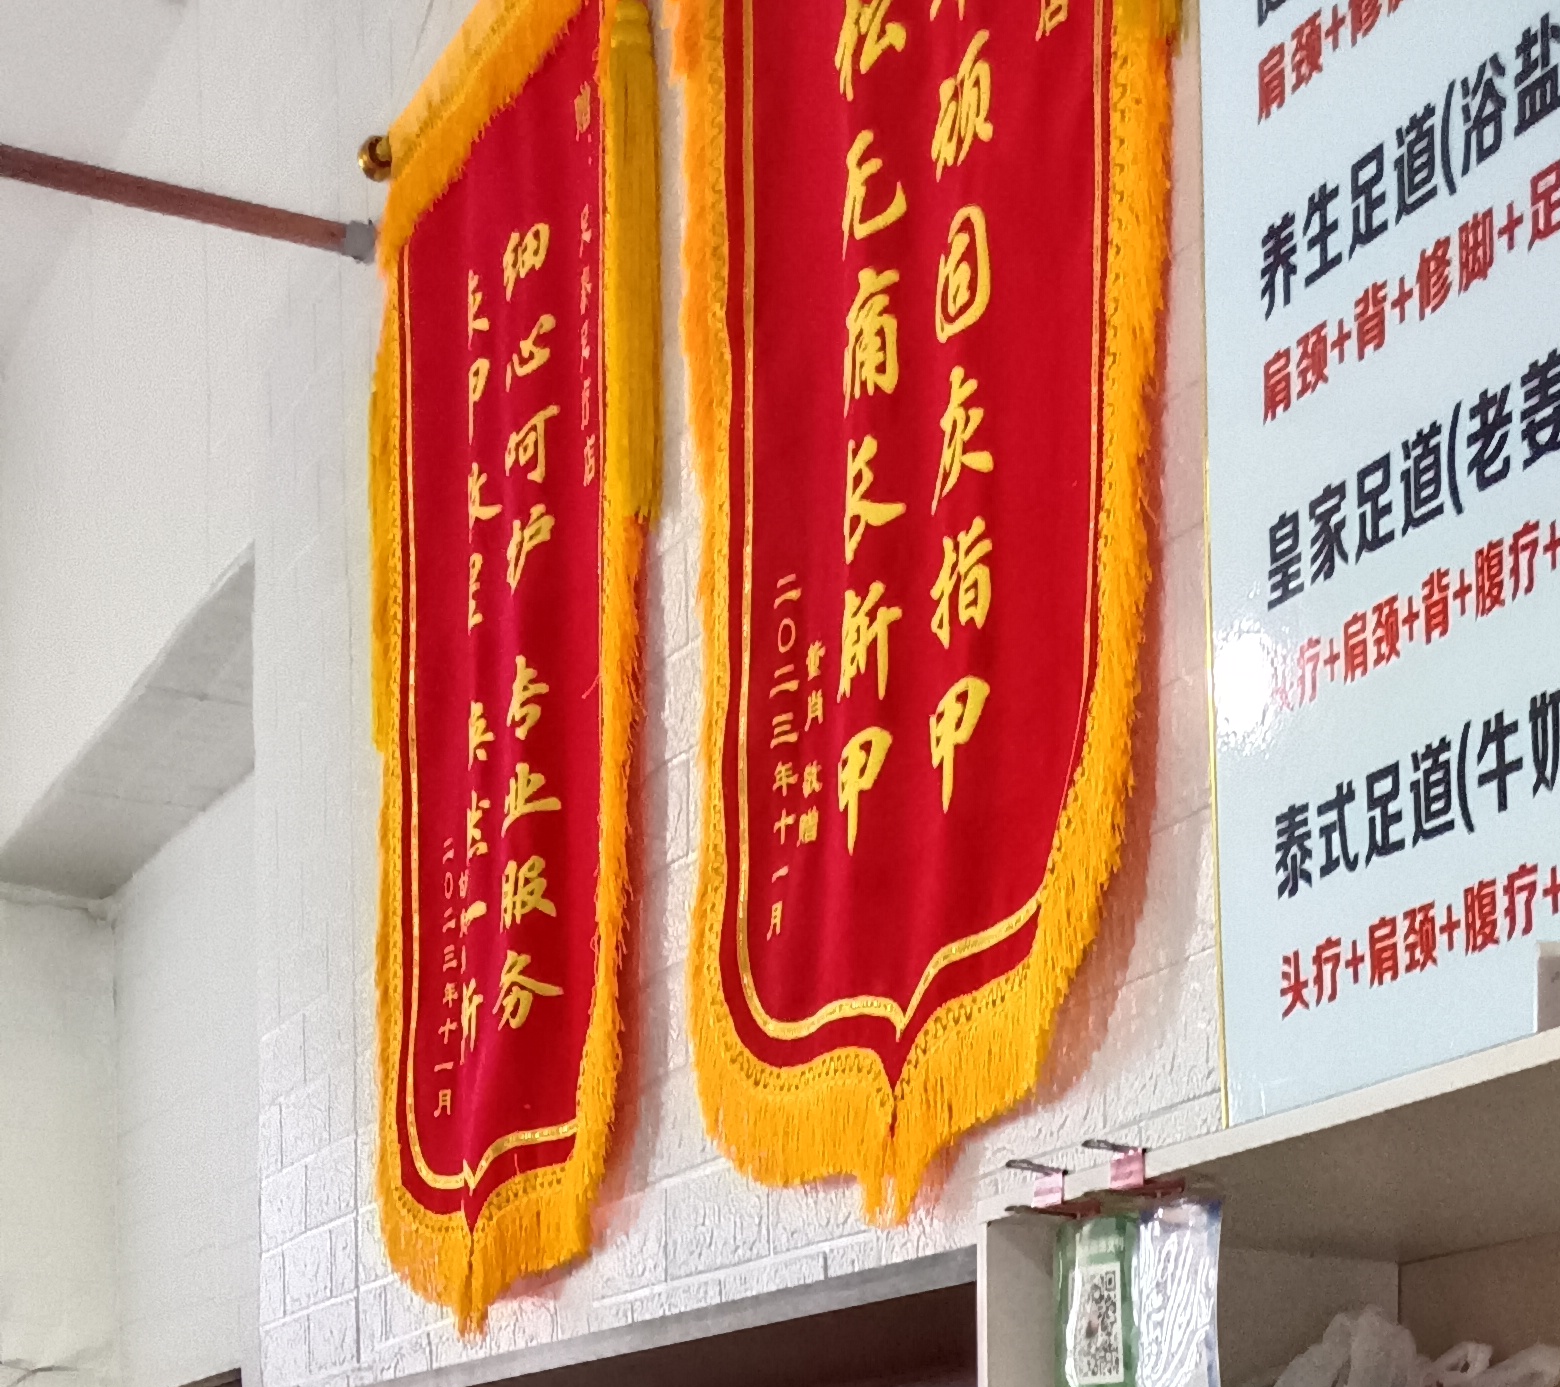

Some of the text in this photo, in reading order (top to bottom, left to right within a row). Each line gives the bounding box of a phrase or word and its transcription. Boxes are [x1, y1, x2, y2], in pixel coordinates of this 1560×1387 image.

[927, 0, 995, 813] 顽固灰指甲
[493, 655, 563, 1031] 专业服务
